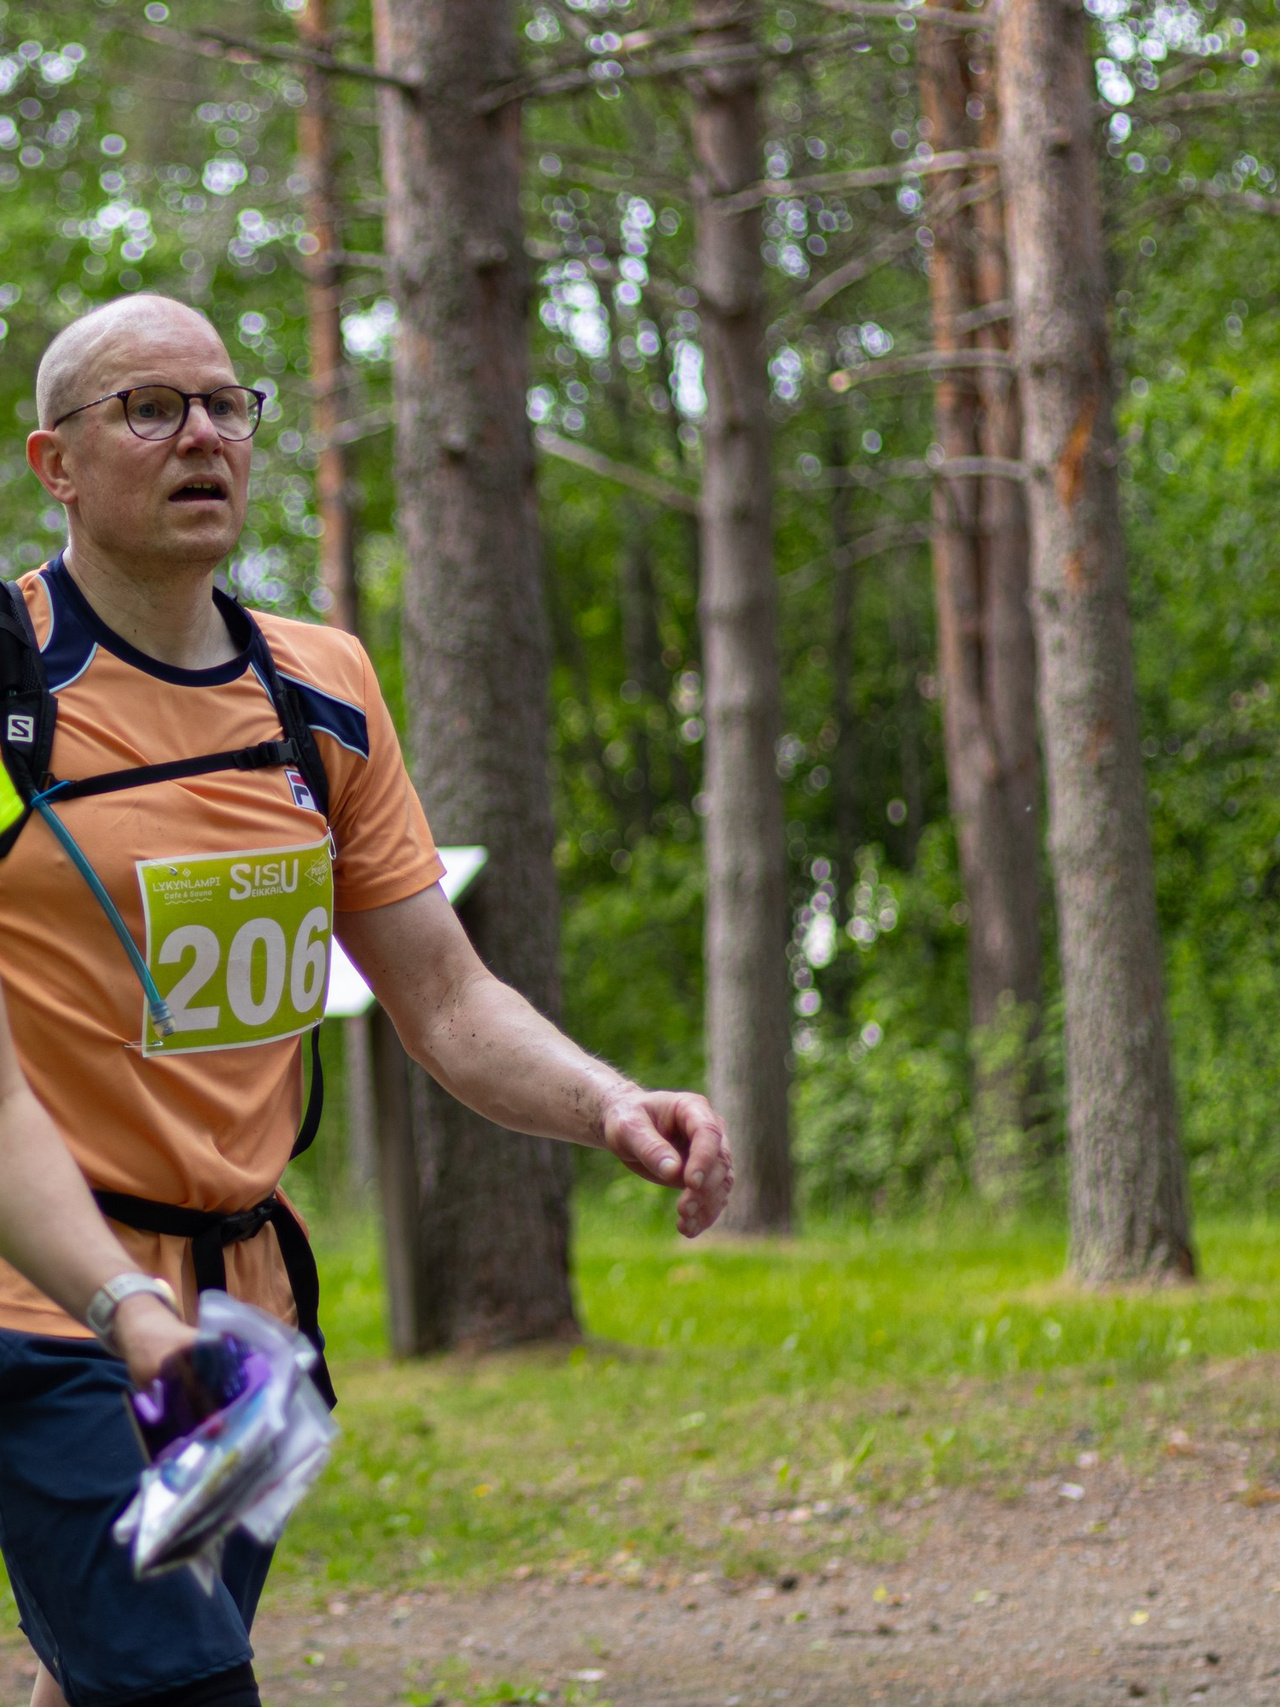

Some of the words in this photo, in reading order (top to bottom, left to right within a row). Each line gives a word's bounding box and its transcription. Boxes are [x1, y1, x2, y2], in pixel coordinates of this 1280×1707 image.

[152, 876, 221, 892] LYKYNLAMPI
[229, 858, 299, 901] SISU
[164, 891, 182, 900] Cafe
[190, 889, 213, 898] Sauna
[158, 906, 329, 1032] 206
